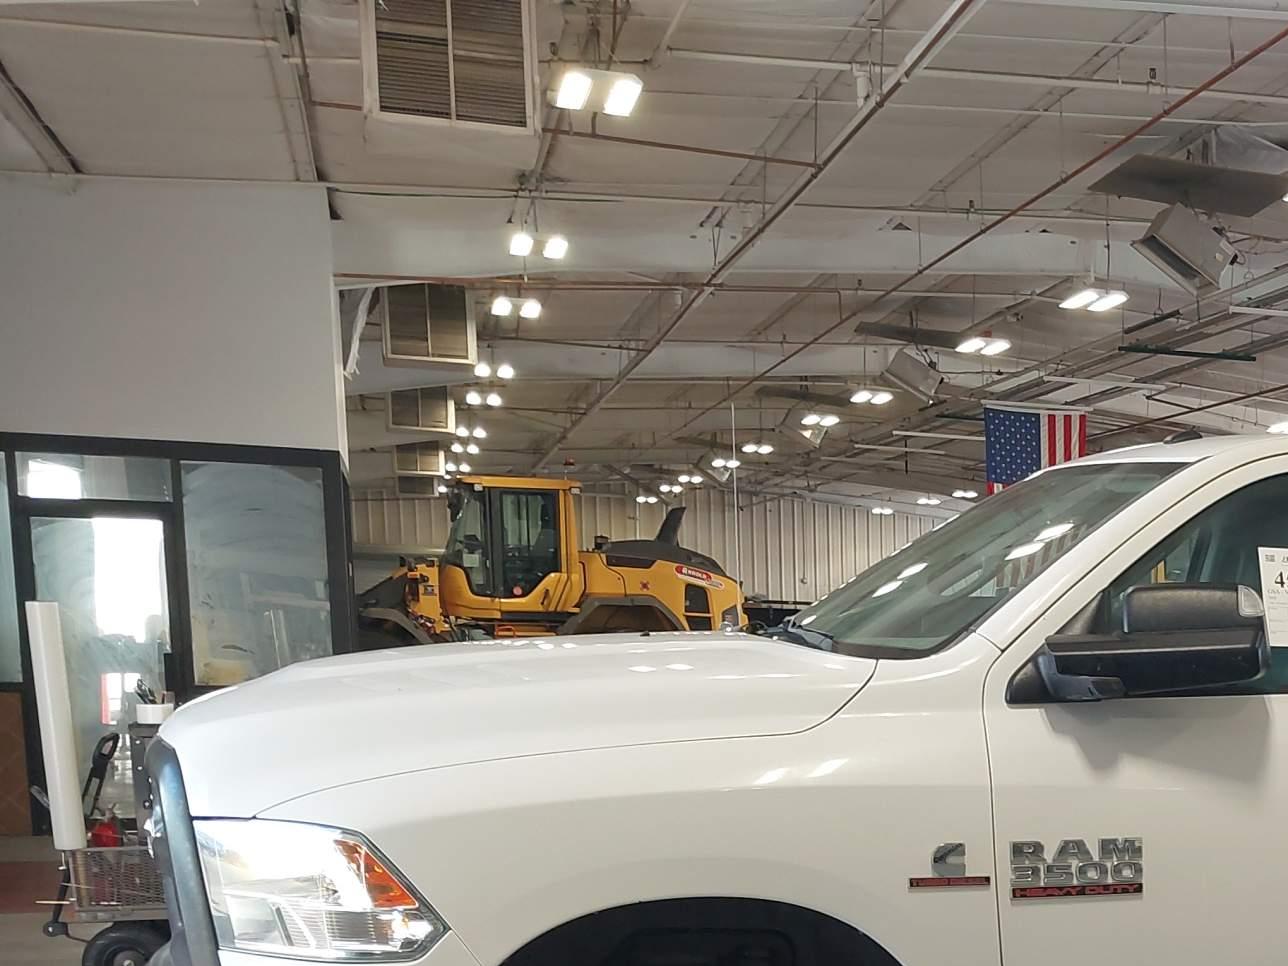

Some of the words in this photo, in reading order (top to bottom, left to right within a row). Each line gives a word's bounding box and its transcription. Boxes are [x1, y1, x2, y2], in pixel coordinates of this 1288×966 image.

[1010, 838, 1143, 864] RAM
[1010, 861, 1143, 884] 3500
[1014, 886, 1082, 898] HEAVY
[1085, 883, 1138, 895] DUTY
